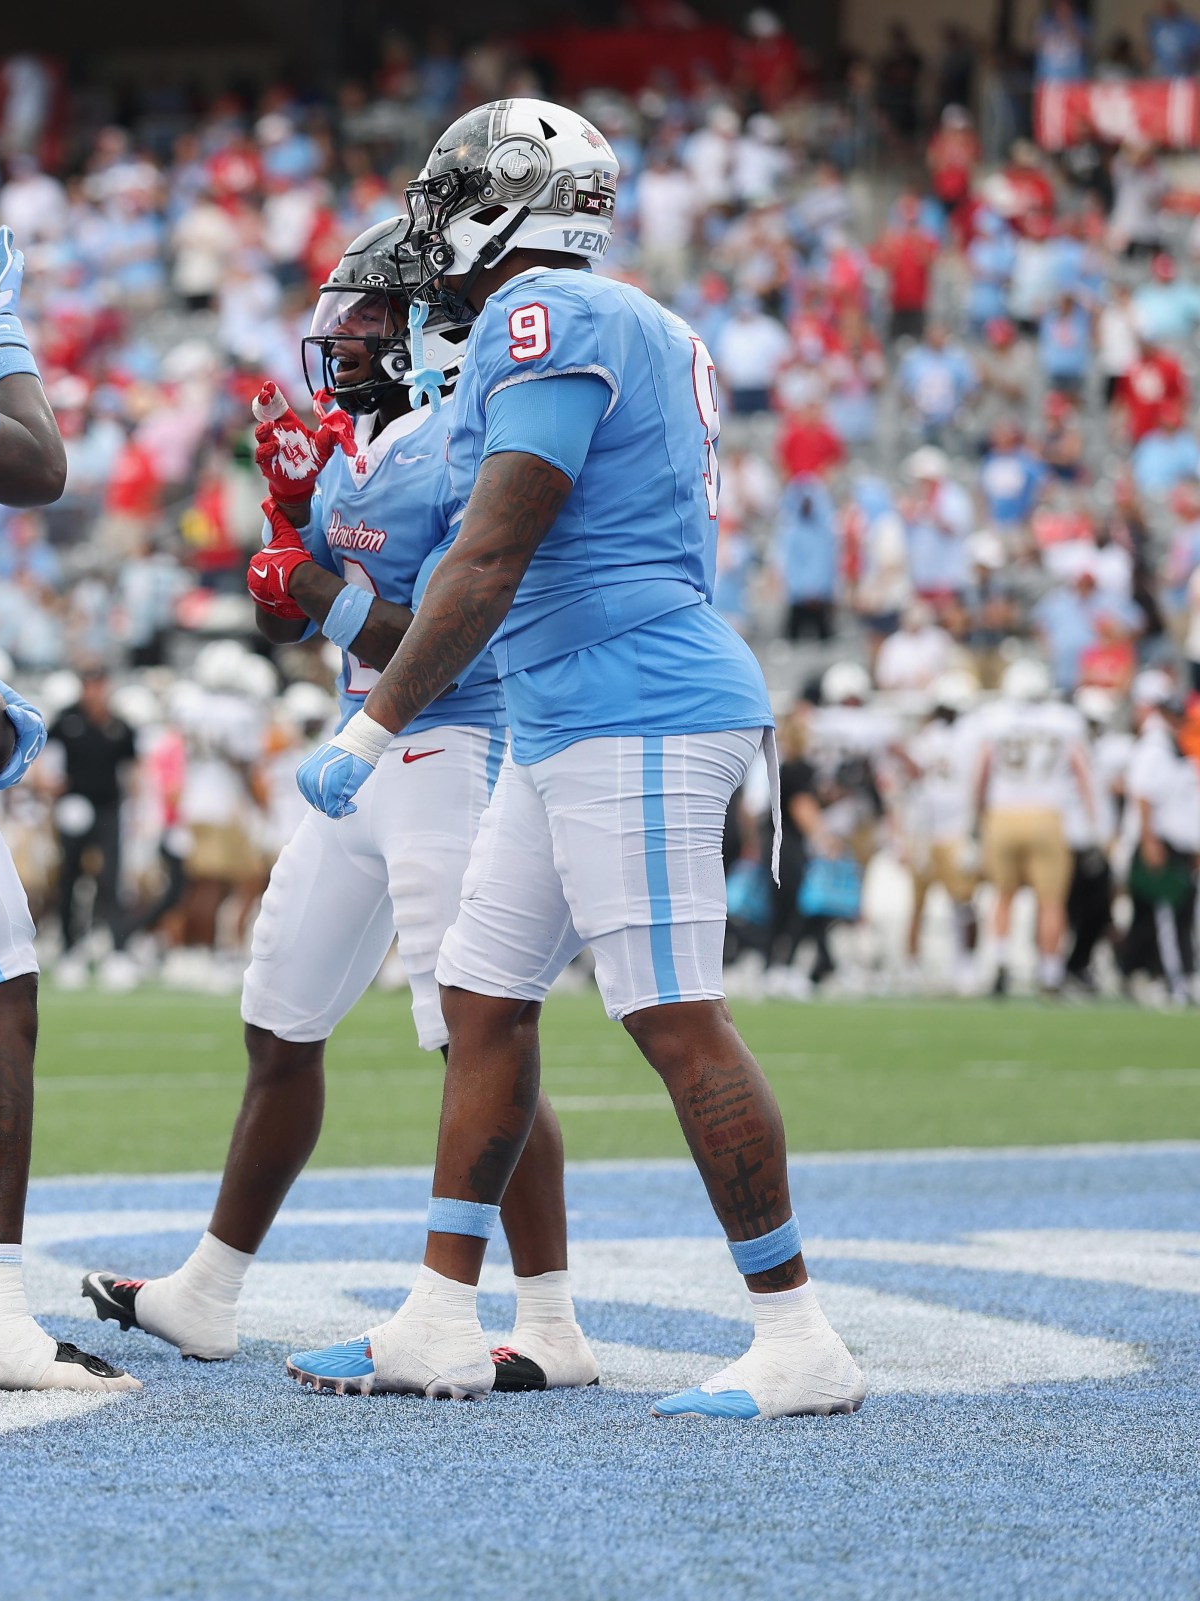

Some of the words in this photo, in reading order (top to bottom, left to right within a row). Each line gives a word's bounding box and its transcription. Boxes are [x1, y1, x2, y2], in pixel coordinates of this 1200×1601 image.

[562, 230, 611, 256] VEN
[508, 302, 551, 363] 9
[327, 509, 387, 554] Houston
